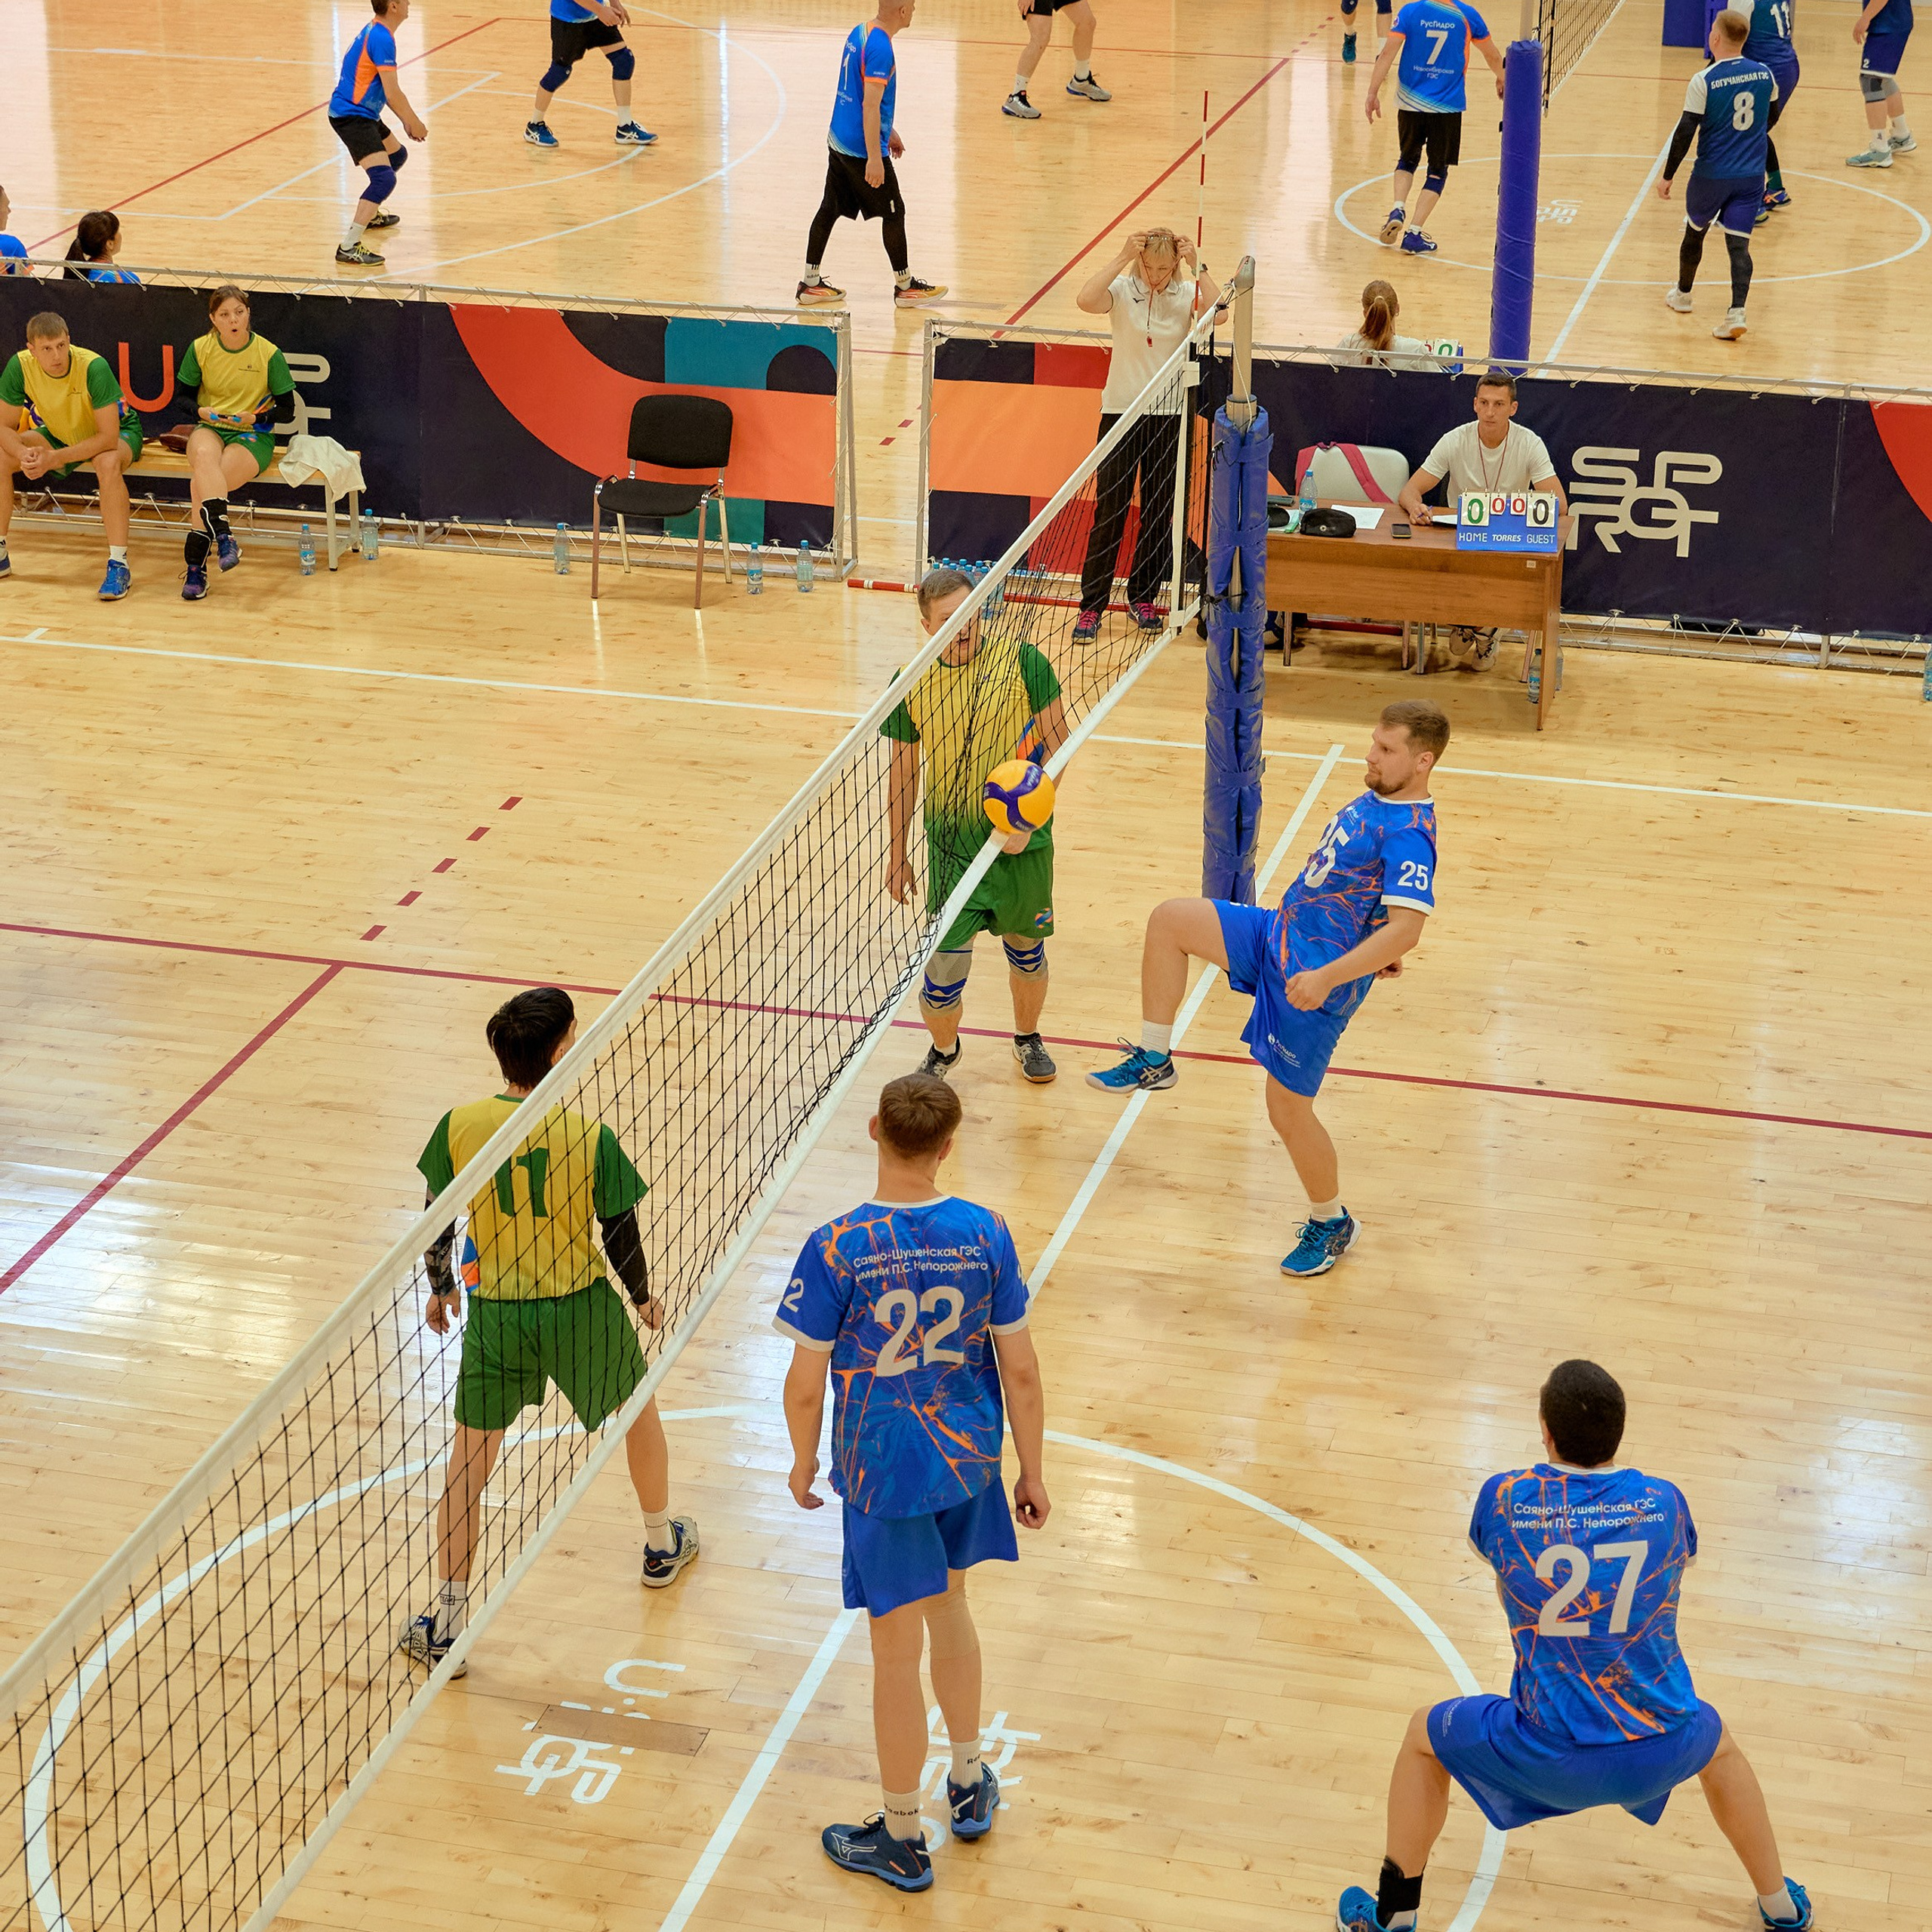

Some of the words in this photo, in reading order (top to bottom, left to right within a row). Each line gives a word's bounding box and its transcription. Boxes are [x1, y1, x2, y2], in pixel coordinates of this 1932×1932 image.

[1420, 20, 1455, 29] РусГидро
[1426, 29, 1448, 65] 7
[1863, 59, 1869, 68] 2
[1711, 73, 1758, 90] БОГУЧАНСКАЯ
[1758, 72, 1769, 80] ГЭС
[1733, 91, 1755, 131] 8
[1467, 498, 1484, 524] 0
[1492, 497, 1505, 513] 0
[1512, 497, 1525, 513] 0
[1533, 499, 1549, 525] 0
[1459, 532, 1487, 543] HOME
[1492, 534, 1521, 543] TORRES
[1527, 534, 1555, 544] GUEST
[1398, 860, 1429, 891] 25
[494, 1147, 549, 1218] 11
[854, 1248, 957, 1269] Саяно-Шушенская
[959, 1245, 981, 1257] ГЭС
[855, 1266, 889, 1283] имени
[914, 1260, 989, 1273] Непорожнего
[783, 1278, 804, 1312] 2
[875, 1286, 965, 1377] 22
[1513, 1503, 1632, 1516] Саяно-Шушенская
[1634, 1498, 1657, 1509] ГЭС
[1512, 1519, 1552, 1529] имени
[1583, 1512, 1665, 1528] Непорожнего
[1535, 1540, 1648, 1636] 27
